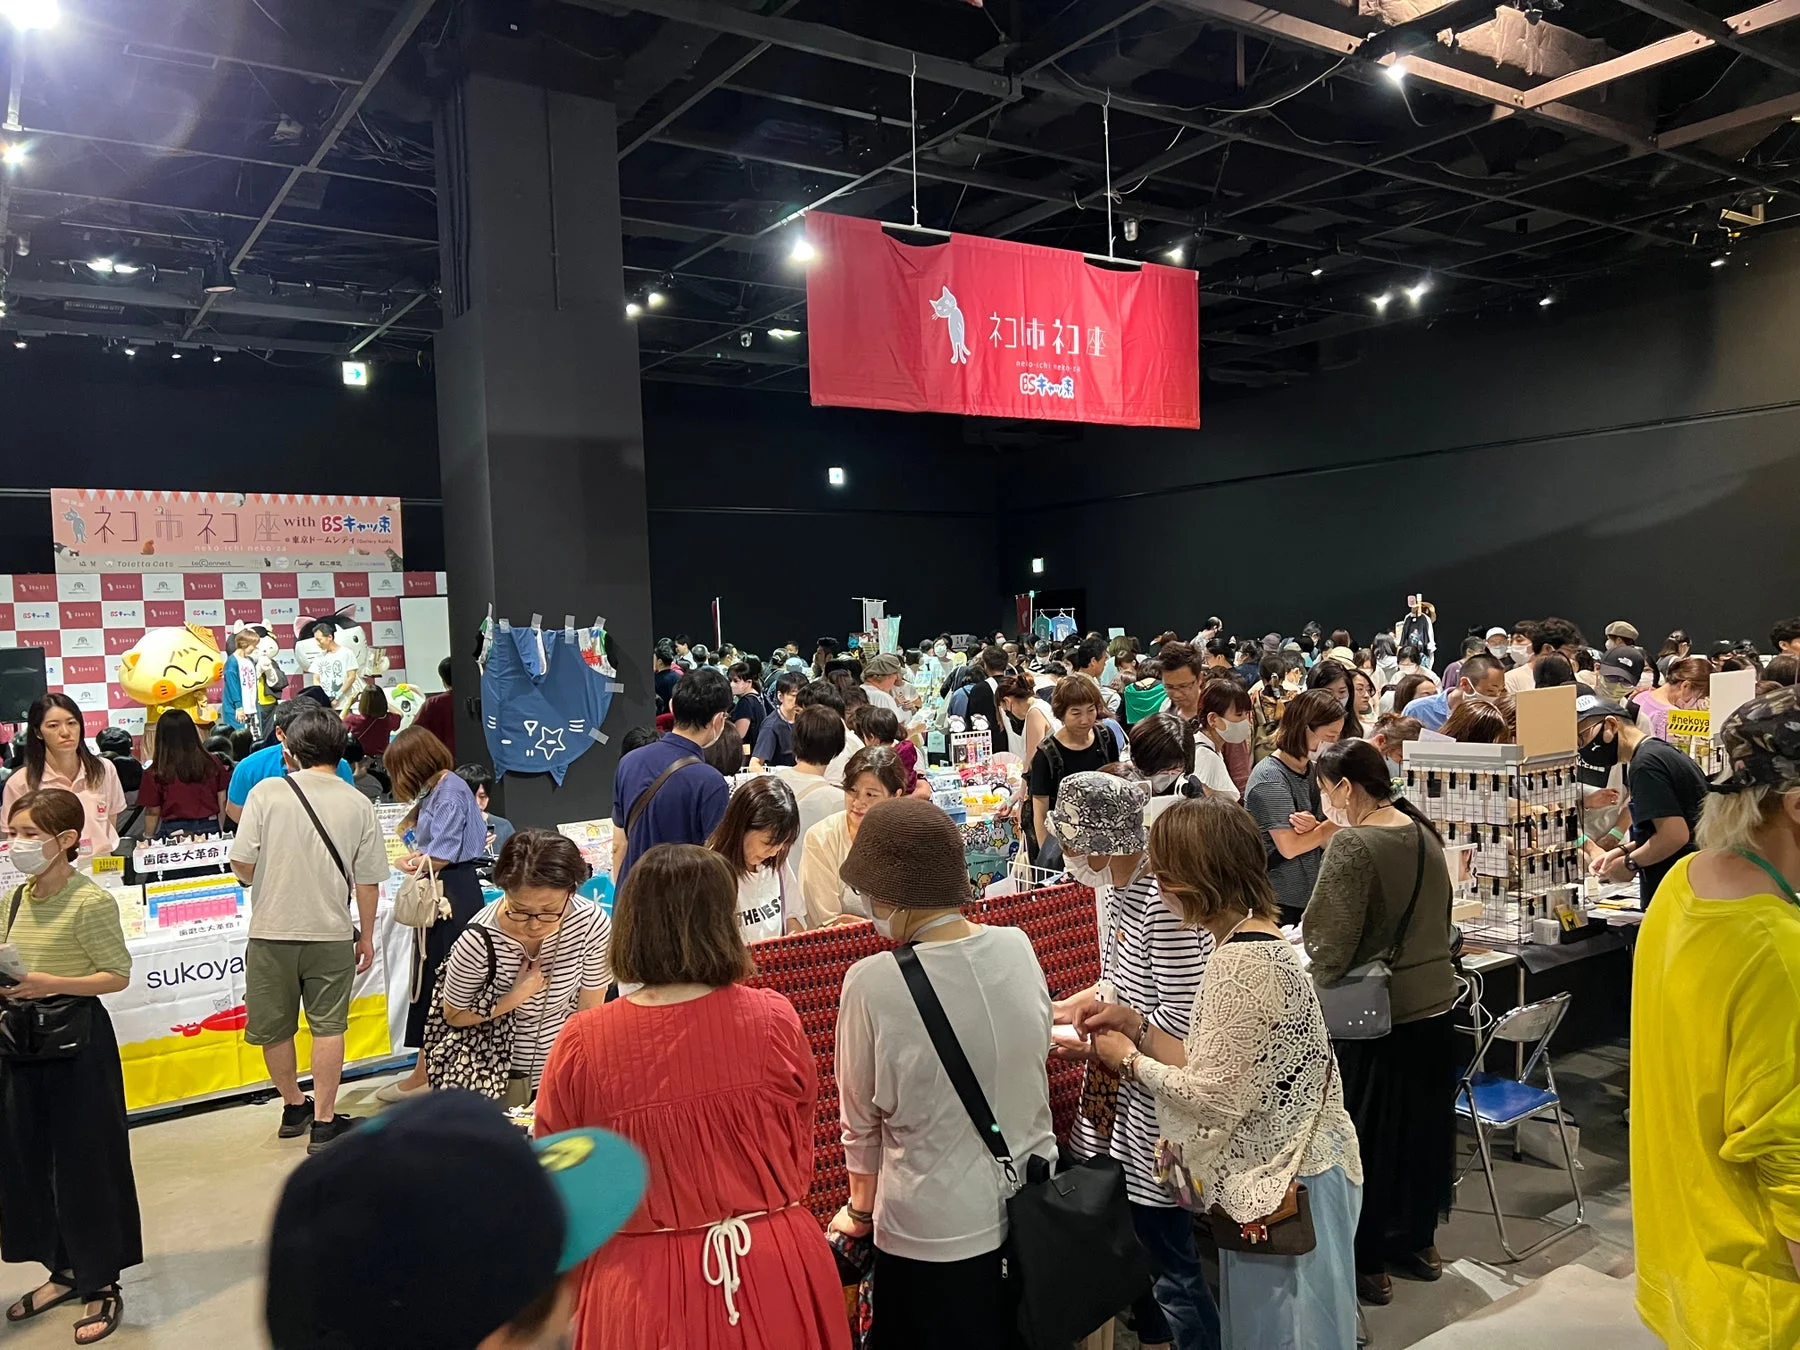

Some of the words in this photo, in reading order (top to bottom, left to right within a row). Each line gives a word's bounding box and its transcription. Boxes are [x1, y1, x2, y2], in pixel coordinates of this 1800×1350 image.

[94, 506, 281, 544] ネコ市ネコ座
[283, 516, 316, 528] with
